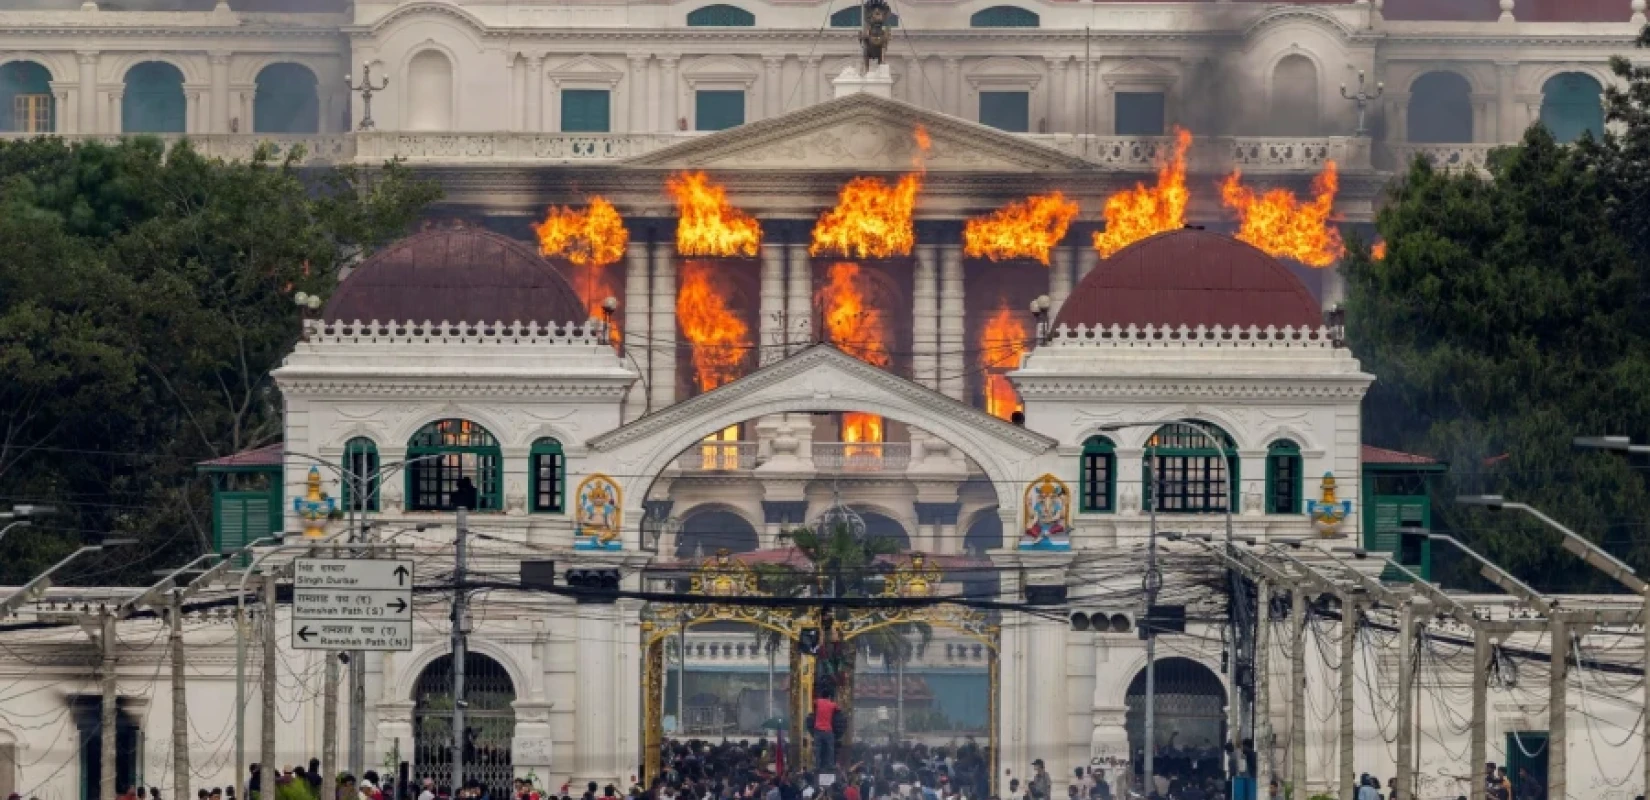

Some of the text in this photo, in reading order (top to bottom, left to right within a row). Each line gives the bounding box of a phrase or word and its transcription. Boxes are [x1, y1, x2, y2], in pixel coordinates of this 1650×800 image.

[297, 576, 358, 585] Singh Durbar
[297, 607, 384, 616] Ramshah Path (S)
[365, 638, 386, 646] Path
[389, 638, 408, 647] (N)
